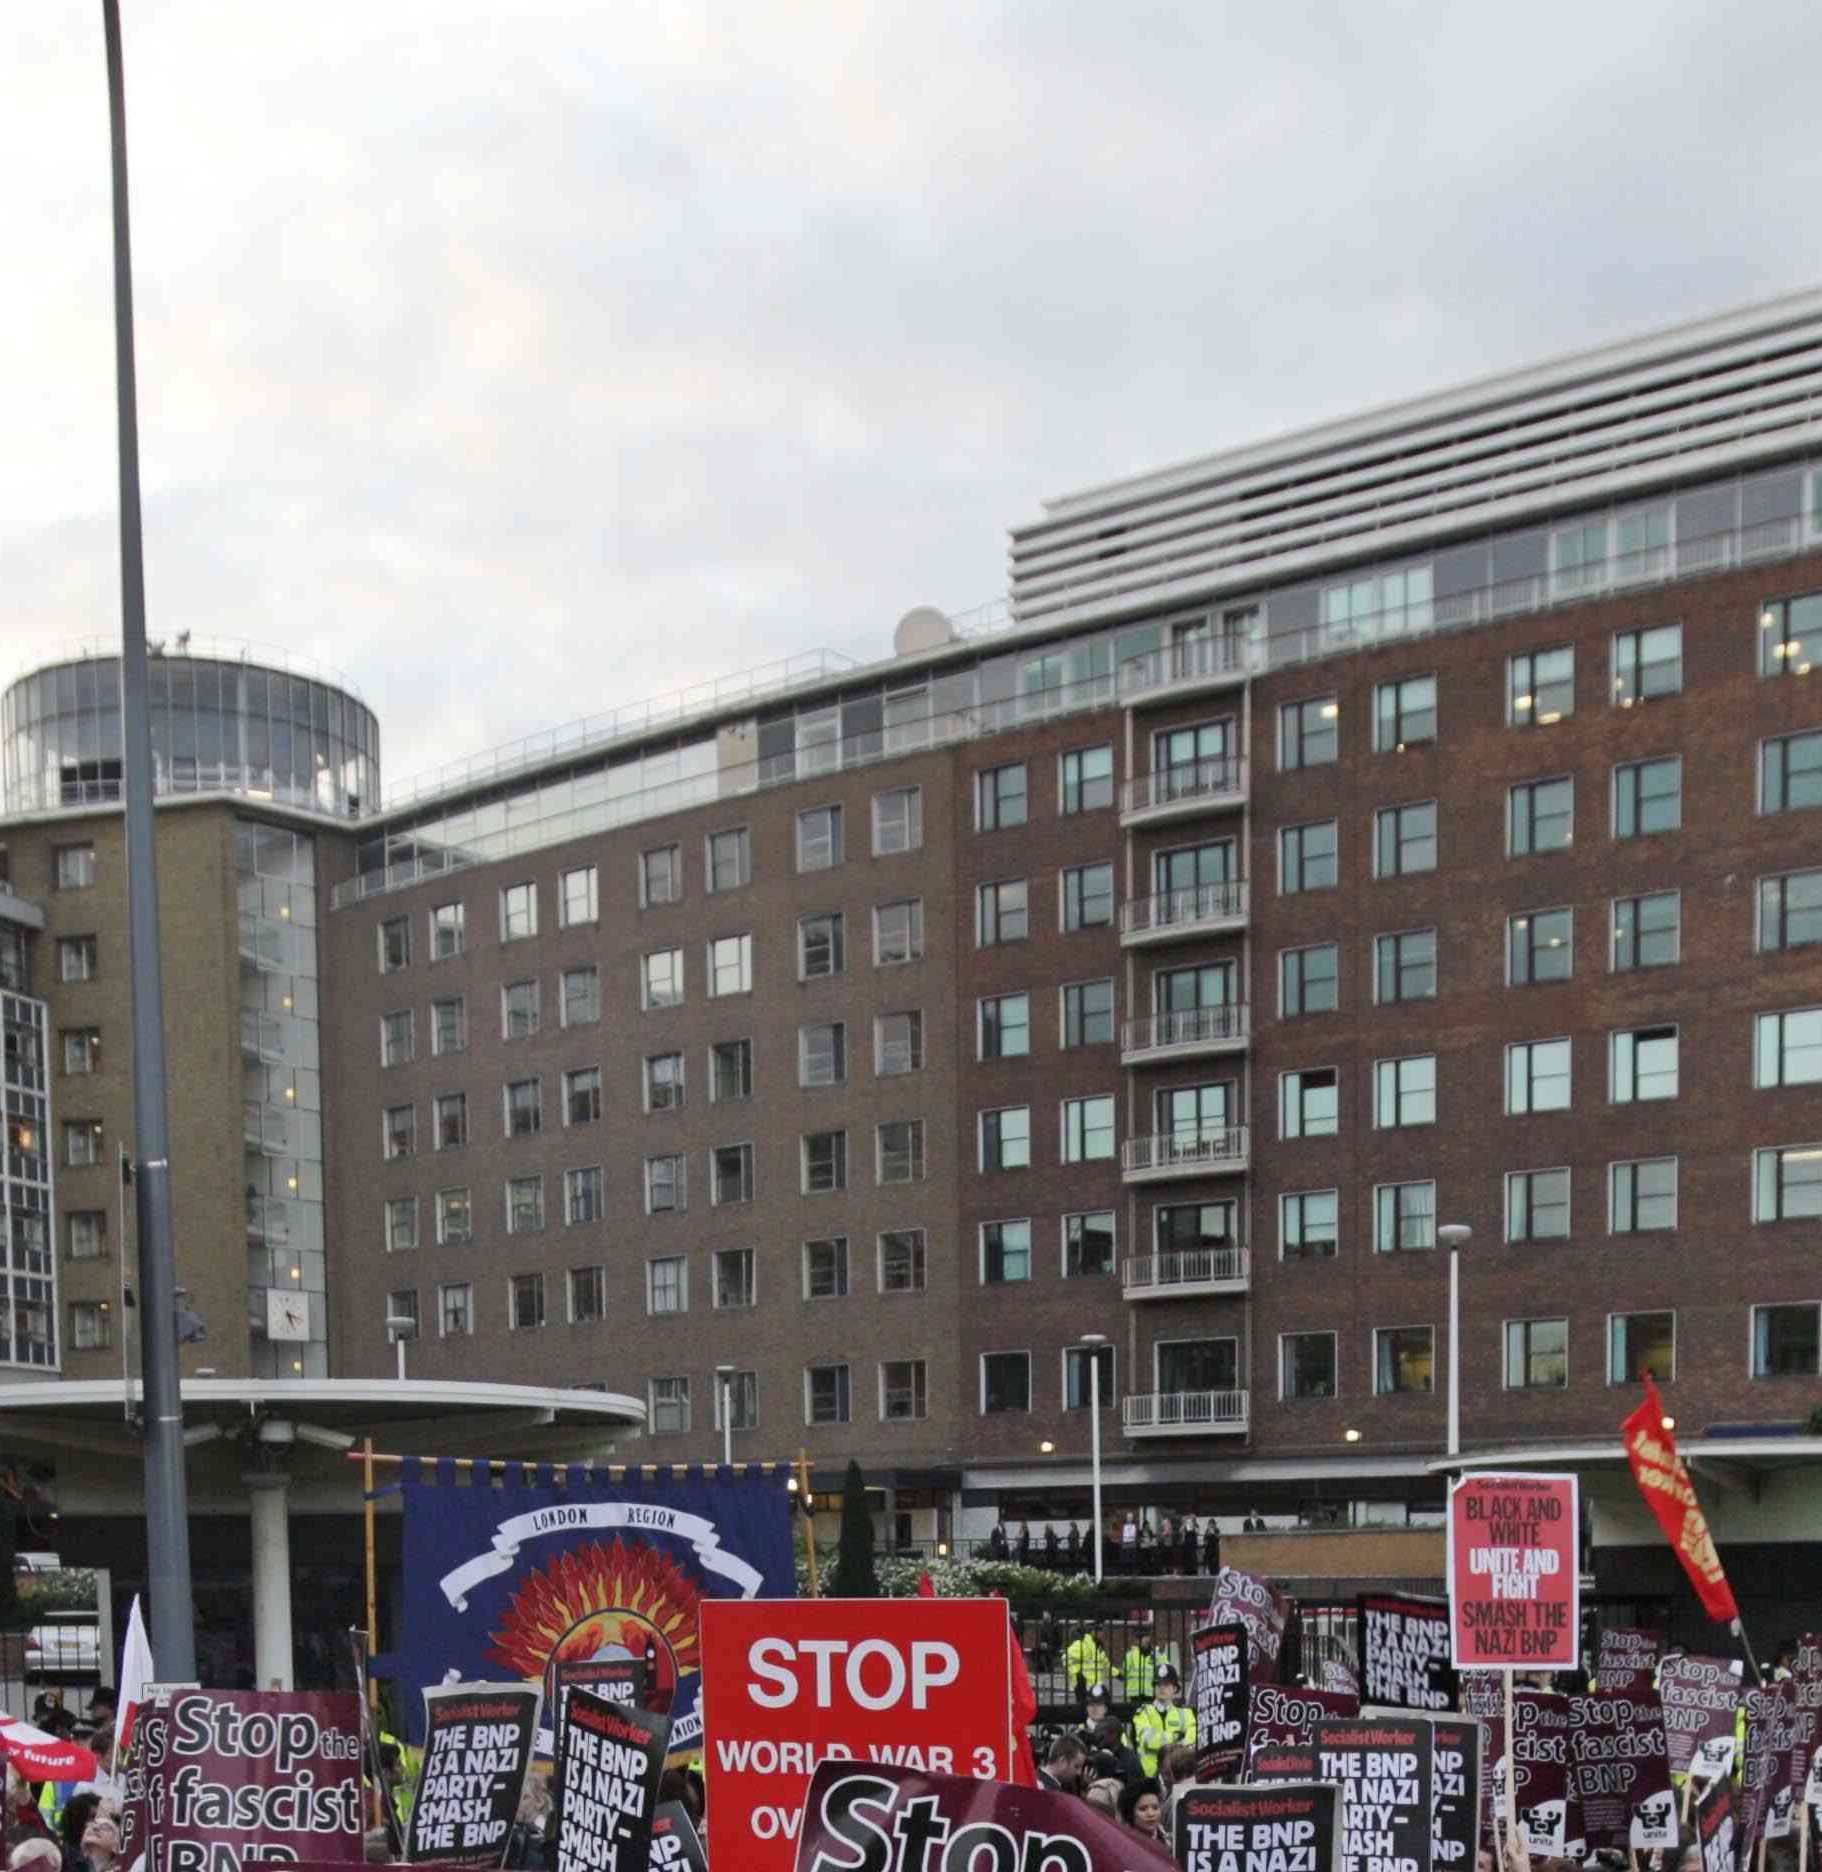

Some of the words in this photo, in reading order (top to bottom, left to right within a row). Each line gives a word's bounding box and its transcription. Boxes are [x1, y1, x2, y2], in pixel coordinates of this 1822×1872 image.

[532, 1508, 588, 1531] LONDON
[628, 1507, 676, 1528] REGION
[1466, 1497, 1522, 1520] BLACK
[1527, 1498, 1562, 1521] AND
[1489, 1522, 1541, 1546] WHITE
[1470, 1548, 1520, 1574] UNITE
[1523, 1549, 1560, 1574] AND
[1492, 1574, 1539, 1599] FIGHT
[1462, 1602, 1527, 1628] SMASH
[1533, 1603, 1568, 1628] THE
[1475, 1628, 1516, 1655] NAZI
[1522, 1629, 1557, 1655] BNP
[747, 1638, 960, 1711] STOP
[1568, 1697, 1632, 1728] Stop
[433, 1728, 466, 1750] THE
[472, 1724, 519, 1747] BNP
[1570, 1727, 1666, 1761] fascist
[24, 1750, 75, 1766] future
[427, 1754, 443, 1774] IS
[444, 1753, 463, 1774] A
[464, 1748, 519, 1772] NAZI
[972, 1747, 996, 1780] 3
[1578, 1764, 1636, 1794] BNP
[417, 1798, 492, 1826] SMASH
[417, 1825, 455, 1851] THE
[463, 1820, 507, 1846] BNP
[1187, 1823, 1244, 1850] THE
[1252, 1820, 1314, 1847] BNP
[1642, 1830, 1668, 1840] unite
[1247, 1846, 1315, 1872] NAZI
